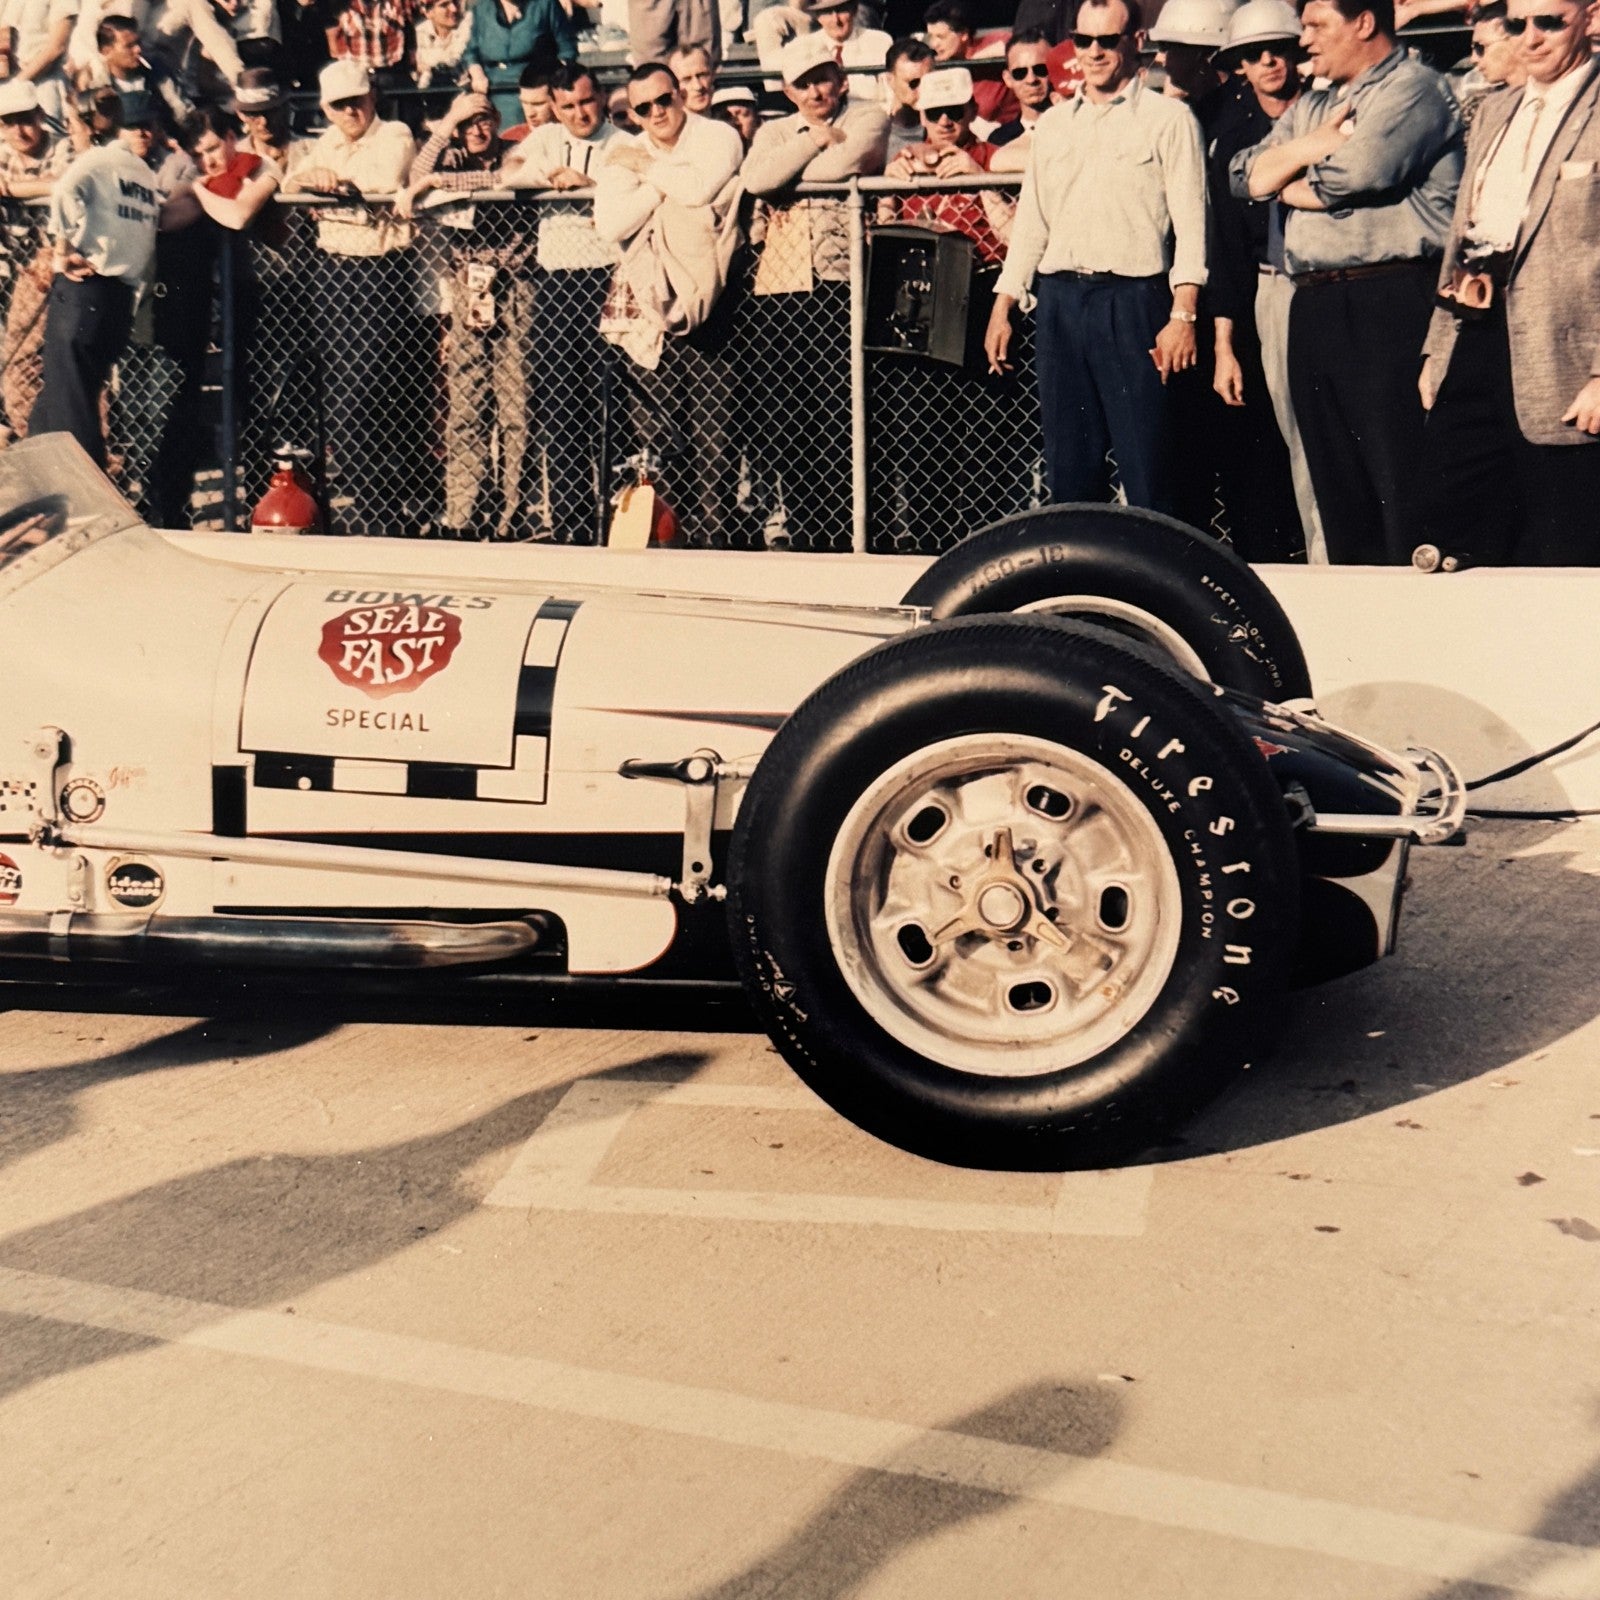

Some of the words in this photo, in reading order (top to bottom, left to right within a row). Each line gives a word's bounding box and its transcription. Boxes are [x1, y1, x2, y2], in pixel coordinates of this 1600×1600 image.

[324, 589, 497, 609] BOWES
[343, 605, 446, 635] SEAL
[338, 635, 446, 685] FAST
[325, 708, 430, 732] SPECIAL
[1093, 684, 1256, 1005] Firestone
[1119, 747, 1182, 814] DELUXE
[1183, 829, 1214, 939] CHAMPION
